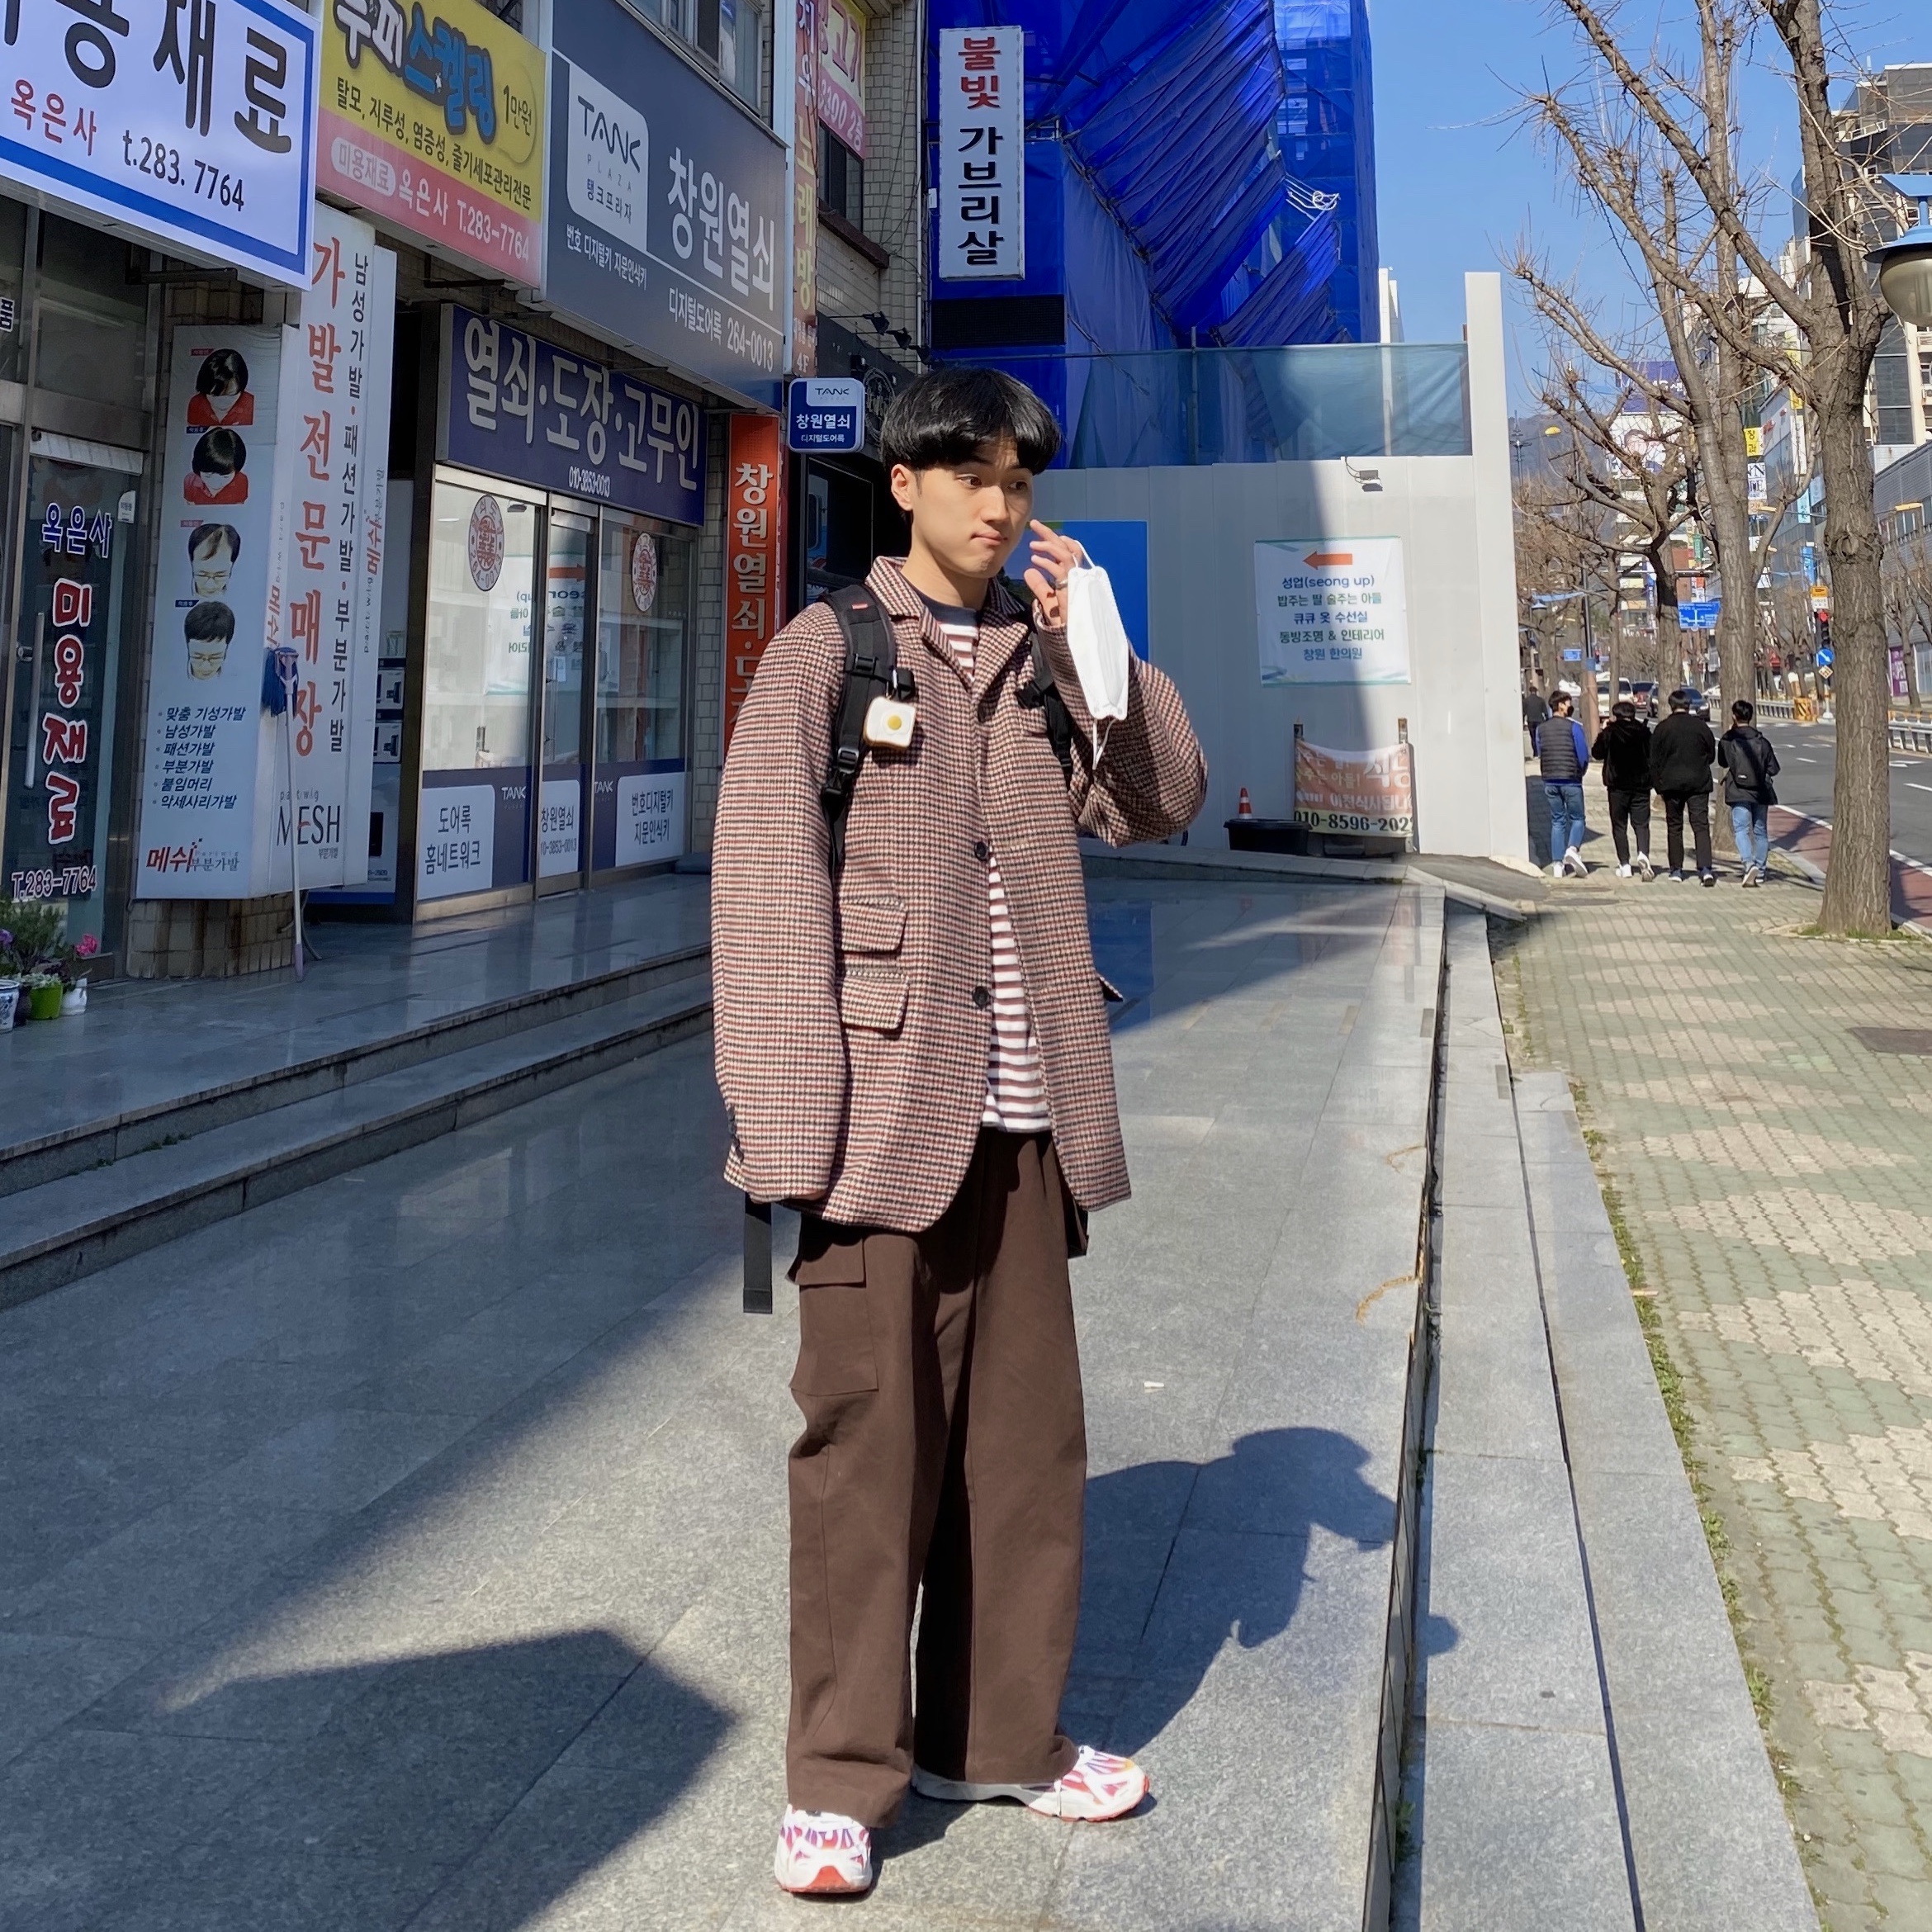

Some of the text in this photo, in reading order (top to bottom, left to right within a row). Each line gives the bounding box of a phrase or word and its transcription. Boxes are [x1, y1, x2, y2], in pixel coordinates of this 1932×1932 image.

[10, 79, 97, 156] 옥은사
[503, 84, 533, 137] 1만원
[578, 95, 642, 173] TANK
[957, 36, 1005, 267] 불빛 가브리살
[586, 154, 632, 192] PLAZA
[338, 142, 530, 262] 미용재료 옥은사 T.283-7764
[796, 115, 817, 310] 노래방
[566, 223, 582, 253] 번호
[667, 147, 774, 311] 창원열쇠
[669, 287, 722, 345] 디지털도어록
[727, 317, 774, 373] 264-0013
[796, 414, 851, 429] 창원열쇠
[801, 434, 845, 443] 디지털도어록
[41, 502, 113, 560] 옥은사
[1353, 575, 1376, 587] up)
[1277, 592, 1382, 607] 밥주는 딸 술주는 아들
[1294, 610, 1368, 625] 큐큐 옷 수선실
[1279, 628, 1385, 644] 동방조명 & 인테리어
[1303, 647, 1363, 661] 창원 한의원
[42, 577, 93, 845] 미용재료
[166, 706, 246, 722] 맞춤 기성가발
[165, 723, 216, 740] 남성가발
[163, 741, 215, 757] 패션가발
[162, 759, 215, 774] 부분가발
[160, 794, 238, 810] 악세사리가발
[500, 785, 527, 801] TANK
[631, 788, 674, 817] 번호디지털키
[276, 804, 341, 846] MESH
[438, 804, 471, 835] 도어록
[540, 805, 575, 833] 창원열쇠
[633, 817, 670, 846] 지문인식키
[424, 840, 481, 875] 홈네트워크
[11, 865, 97, 902] T.283-7764
